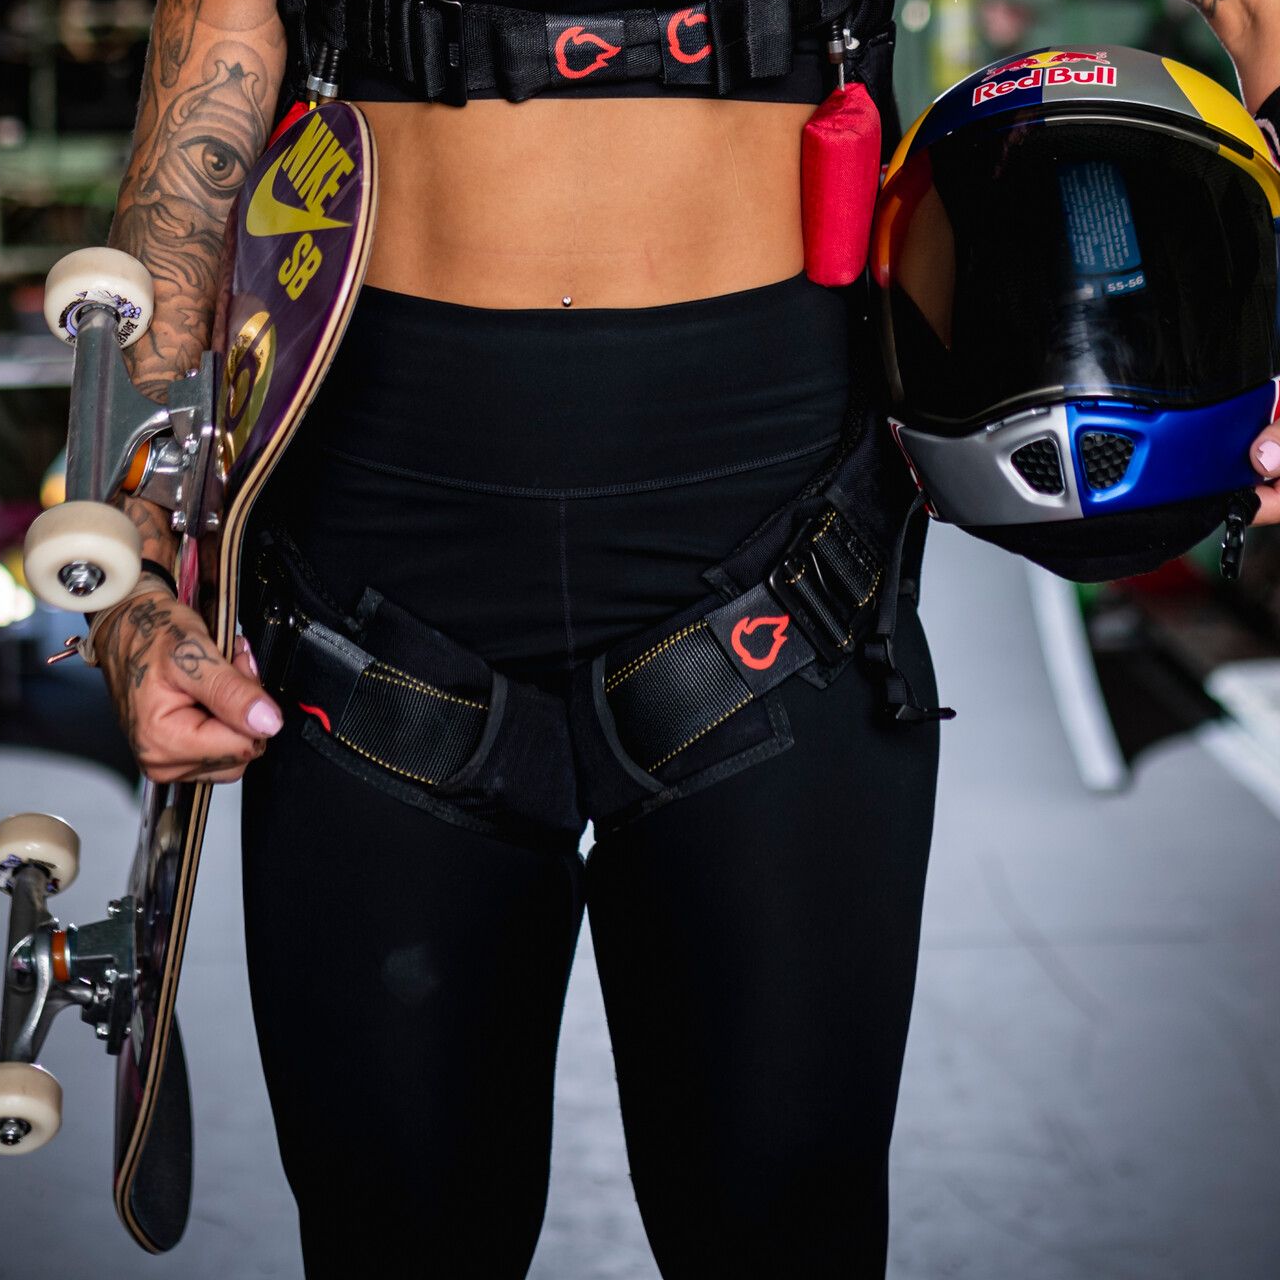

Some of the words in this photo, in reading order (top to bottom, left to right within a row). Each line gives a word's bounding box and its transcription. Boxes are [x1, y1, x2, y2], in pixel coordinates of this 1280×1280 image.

[972, 68, 1043, 107] Red
[1045, 65, 1117, 87] Bull
[281, 112, 356, 218] NIKE
[278, 233, 323, 301] SB
[1107, 276, 1144, 293] 55-56
